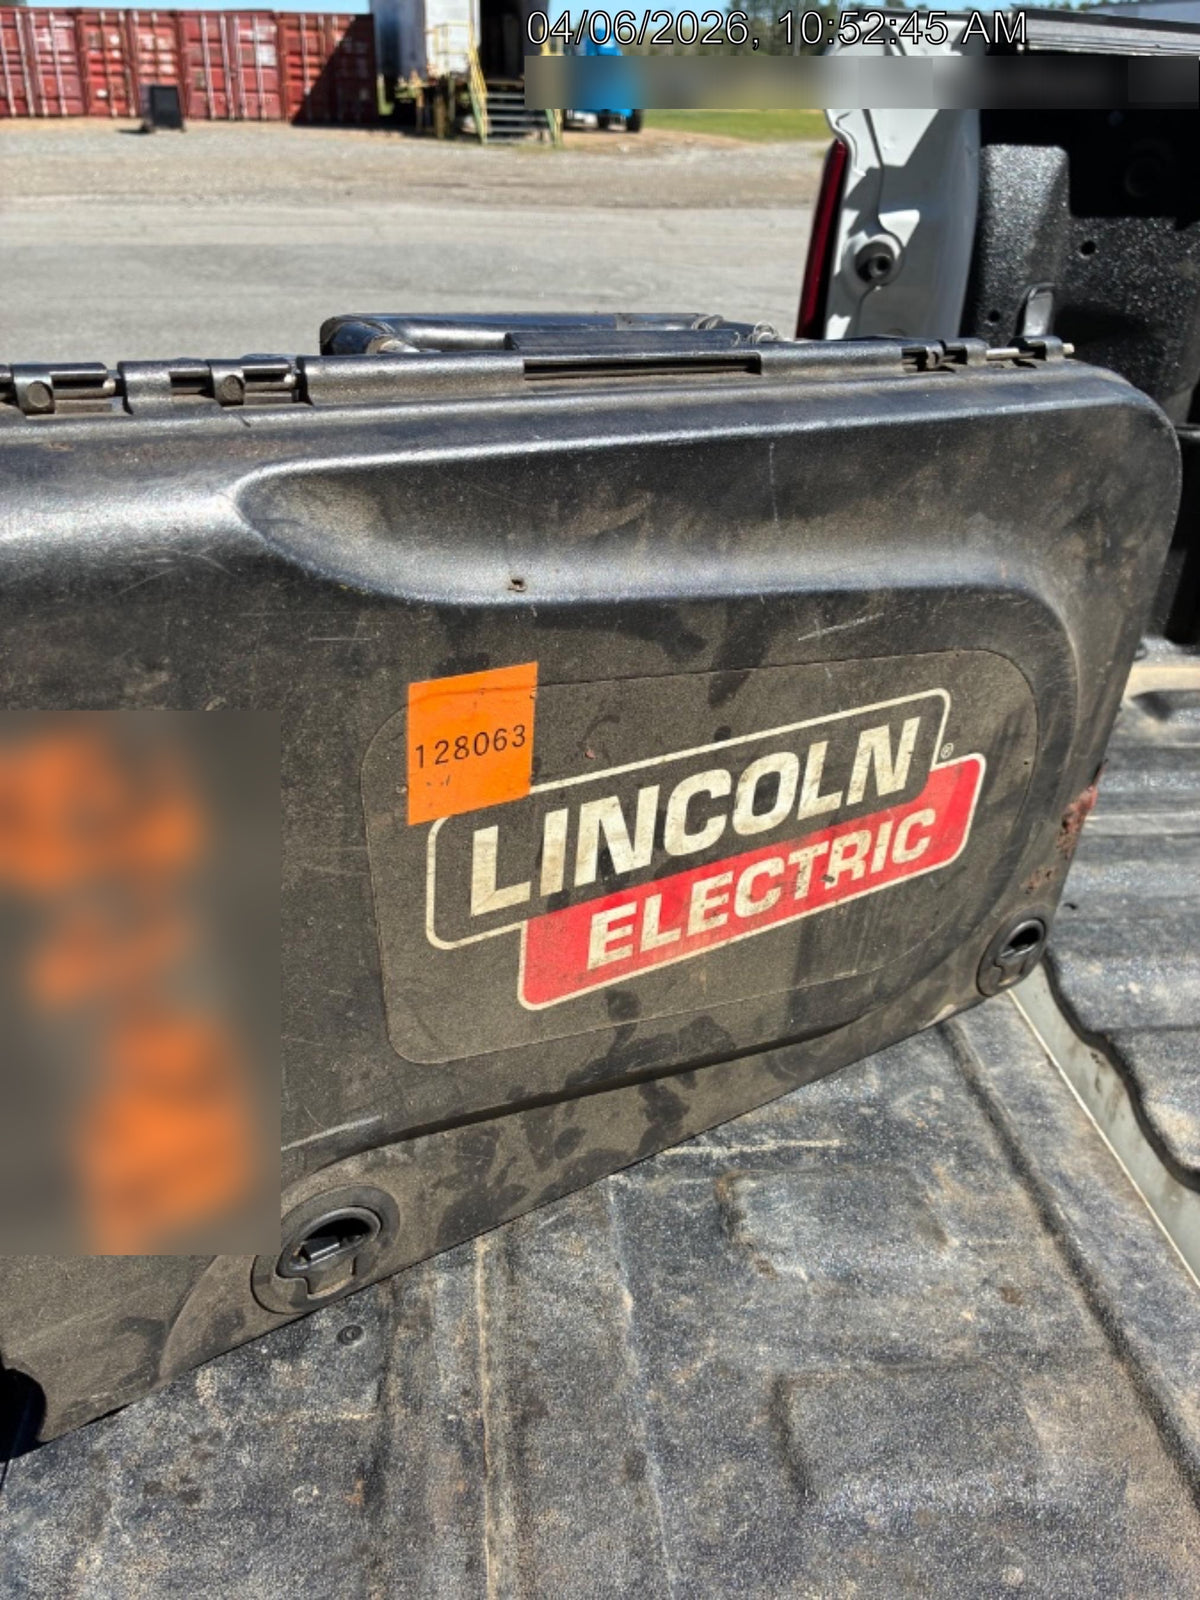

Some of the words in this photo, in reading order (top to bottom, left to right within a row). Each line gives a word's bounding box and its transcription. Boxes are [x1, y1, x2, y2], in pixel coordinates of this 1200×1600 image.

[415, 724, 527, 769] 128063
[470, 716, 921, 917] LINCOLN
[587, 807, 937, 971] ELECTRIC
